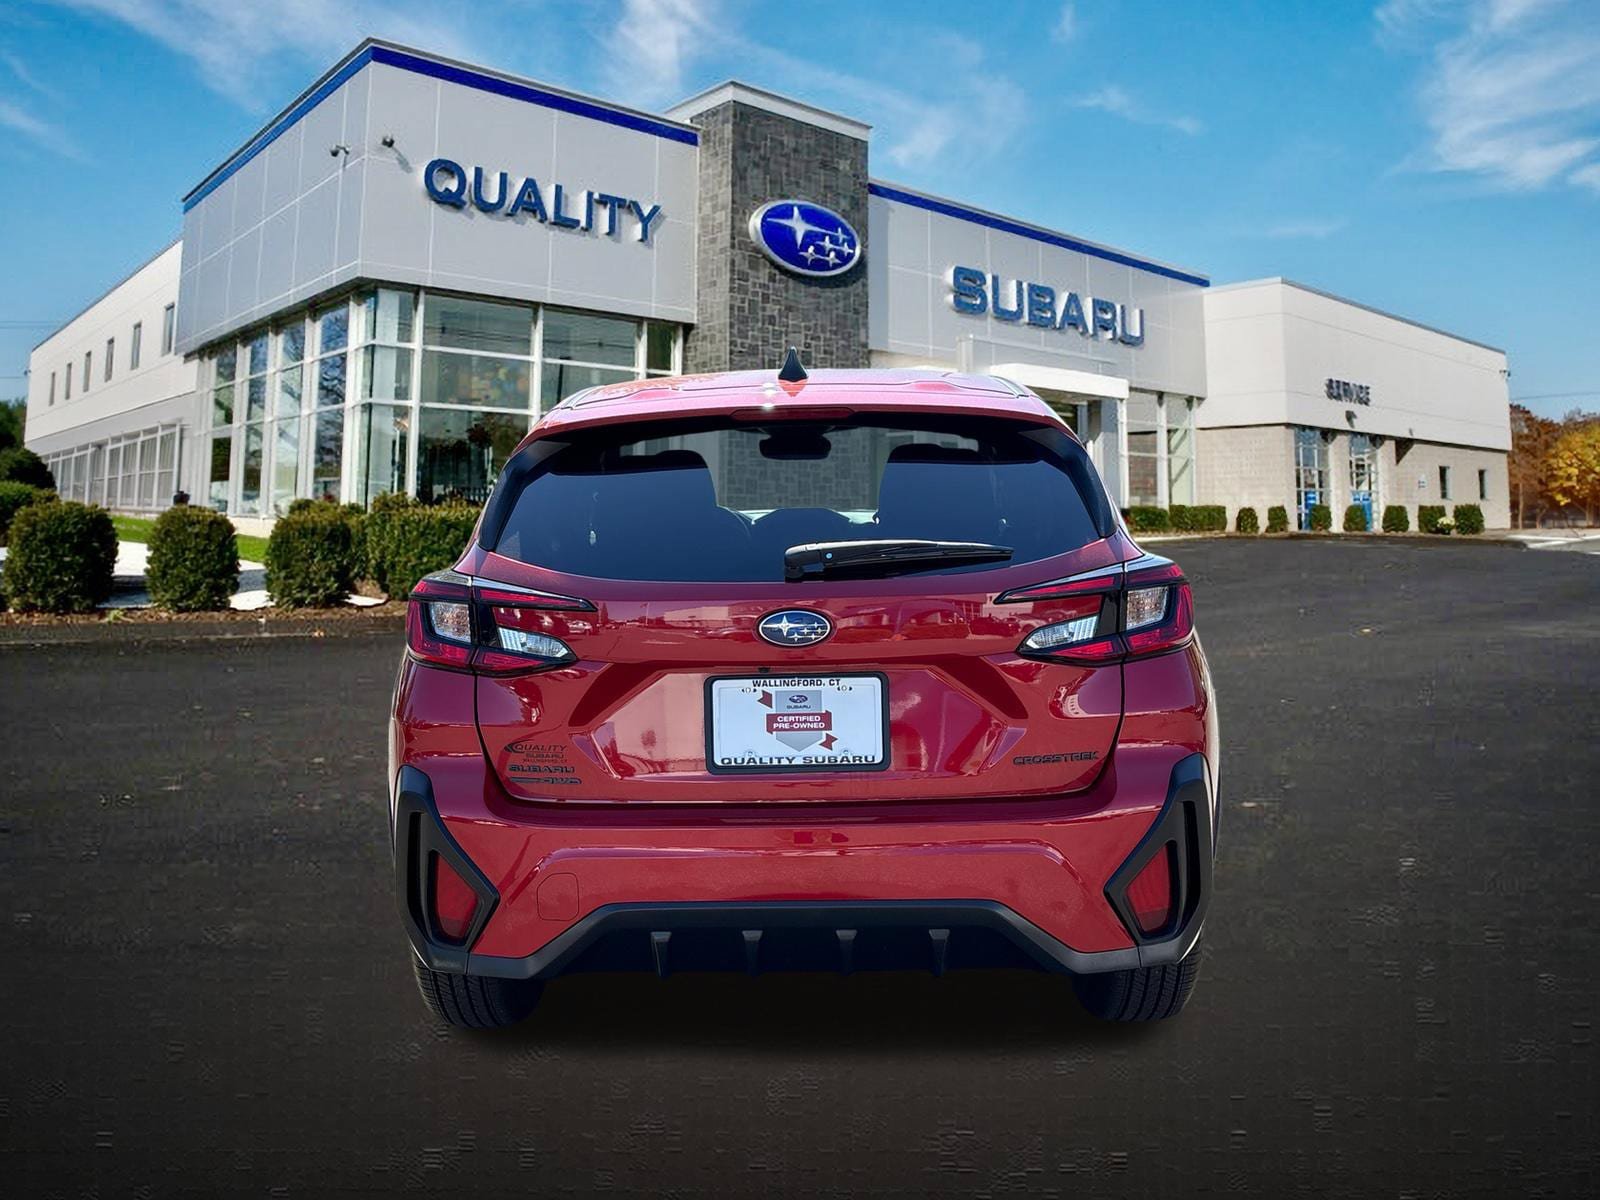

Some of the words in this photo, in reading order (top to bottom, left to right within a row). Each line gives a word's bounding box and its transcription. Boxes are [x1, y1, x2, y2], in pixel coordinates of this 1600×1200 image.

[424, 158, 661, 243] QUALITY
[946, 265, 1145, 347] SUBARU
[828, 678, 841, 687] CT
[777, 715, 821, 723] CERTIFIED
[773, 722, 825, 730] PRE-OWNED
[507, 743, 567, 753] QUALITY
[720, 756, 796, 766] QUALITY
[802, 755, 876, 765] SUBARU
[1013, 751, 1099, 765] CROSSTREK
[509, 764, 575, 773] SUBARU
